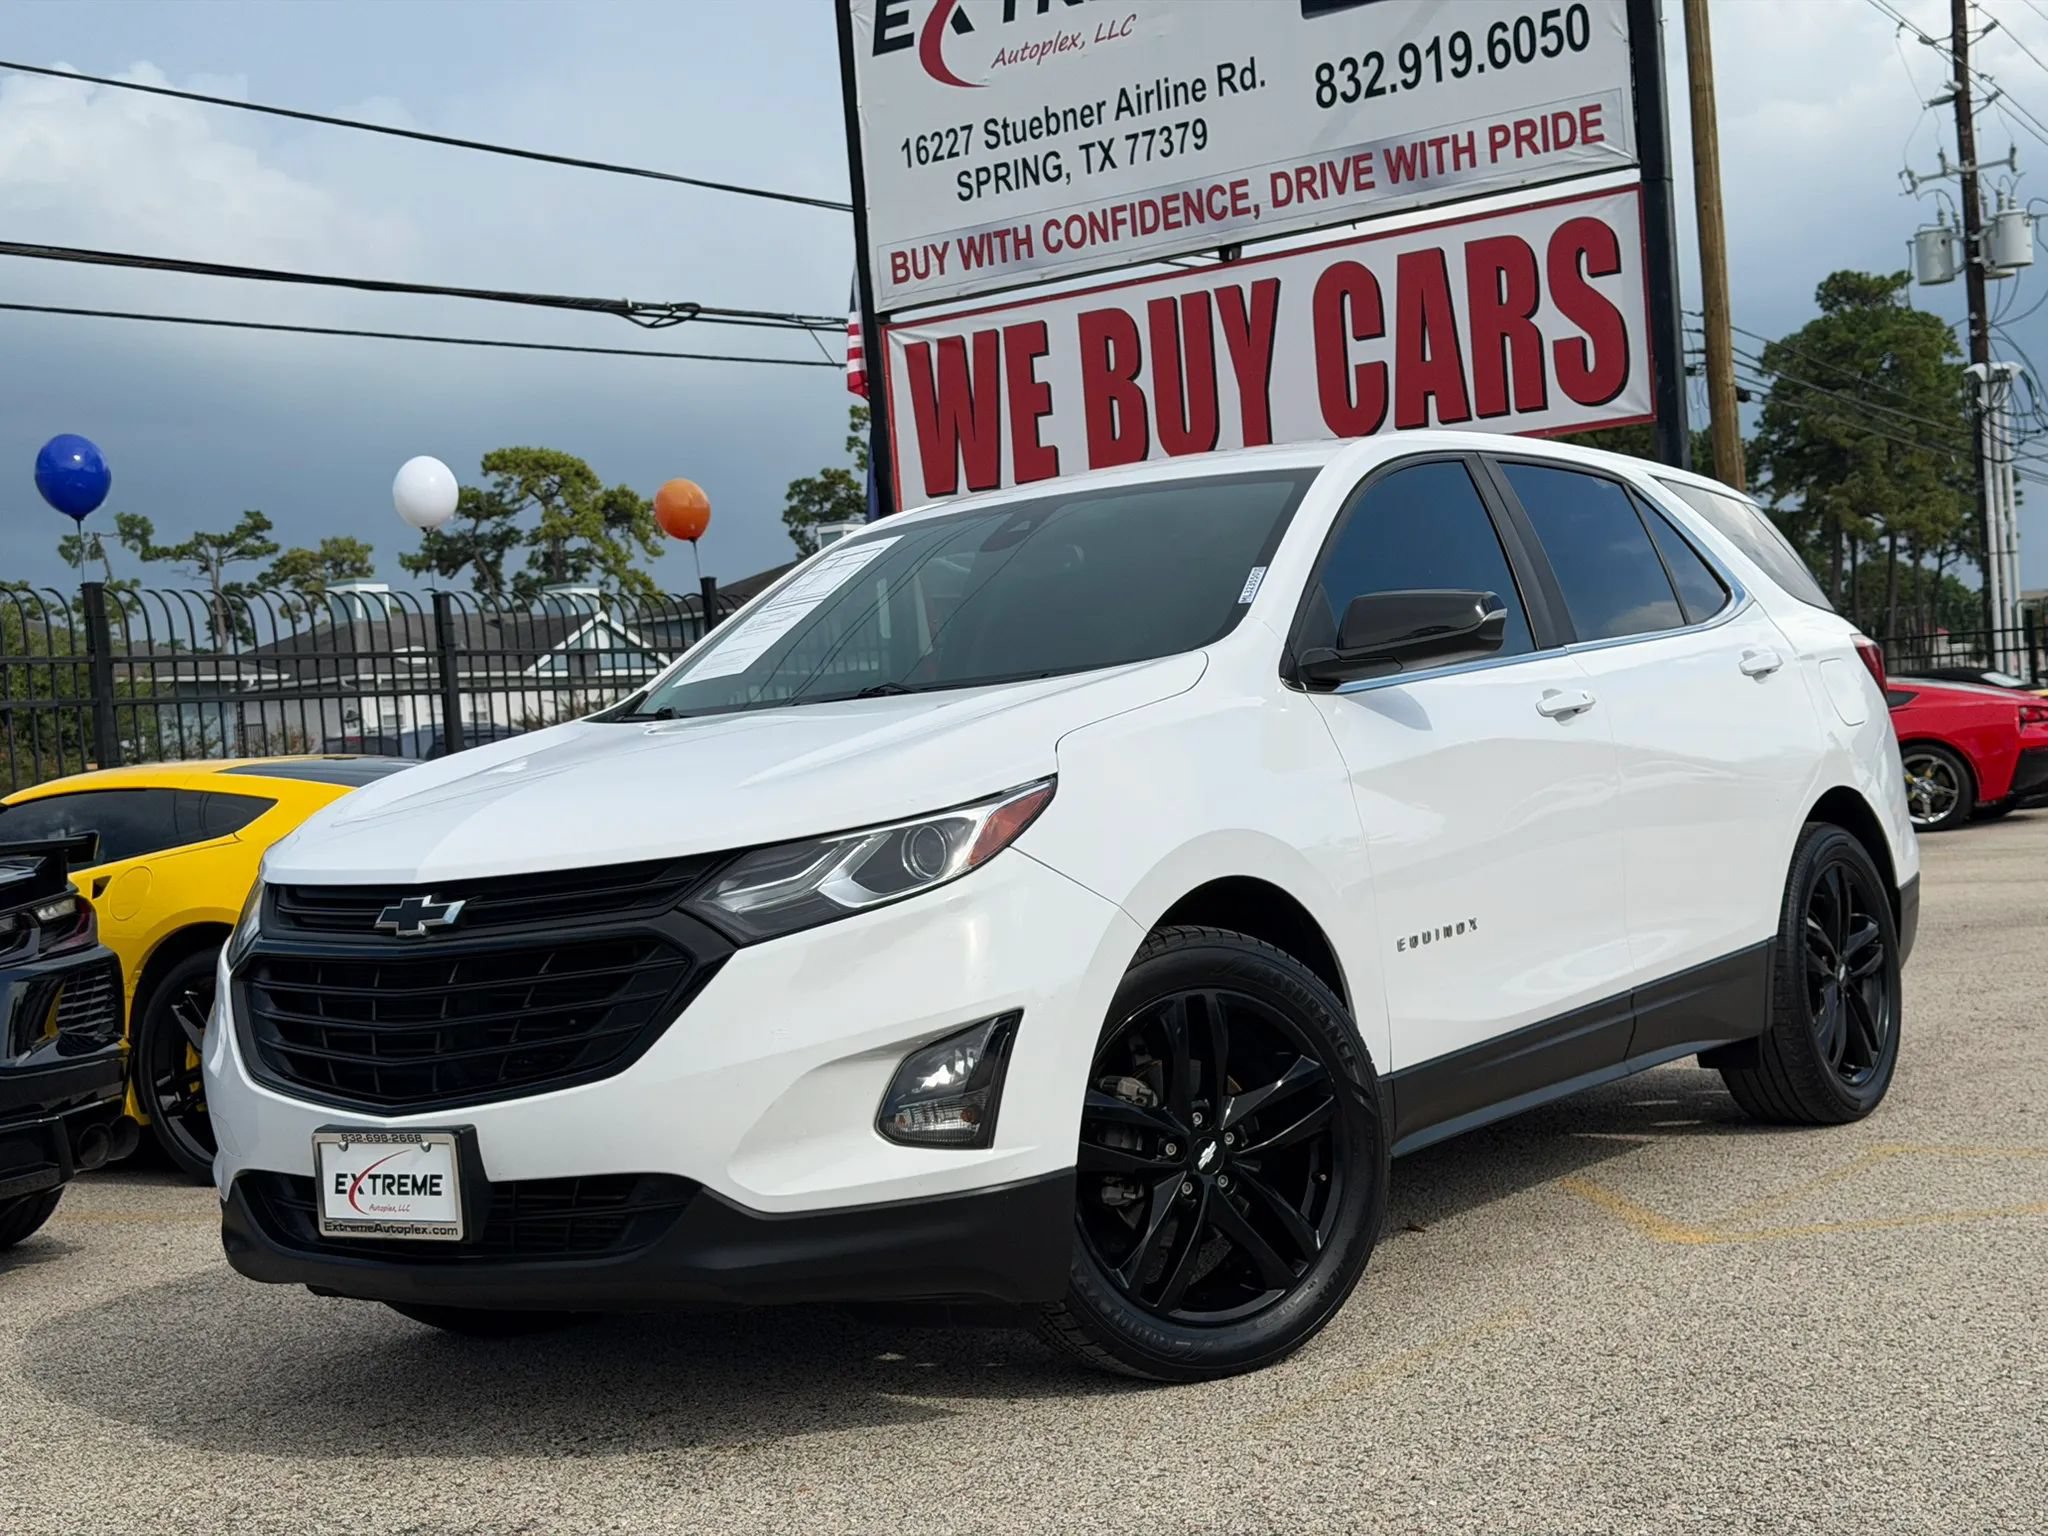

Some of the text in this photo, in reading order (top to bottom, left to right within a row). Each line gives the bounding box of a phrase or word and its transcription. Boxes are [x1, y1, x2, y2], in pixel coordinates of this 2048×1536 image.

[991, 30, 1085, 69] Autoplex,
[1094, 14, 1137, 44] LLC
[1314, 3, 1590, 109] 832.919.6050
[900, 56, 1266, 168] 16227 Stuebner Airline Rd.
[891, 103, 1605, 285] BUY WITH CONFIDENCE, DRIVE WITH PRIDE
[956, 118, 1208, 202] SPRING, TX 77379
[903, 216, 1630, 498] WE BUY CARS
[1396, 917, 1478, 952] EQUINOX
[335, 1173, 442, 1196] EXTREME
[324, 1221, 458, 1236] ExtremeAutoplex.com
